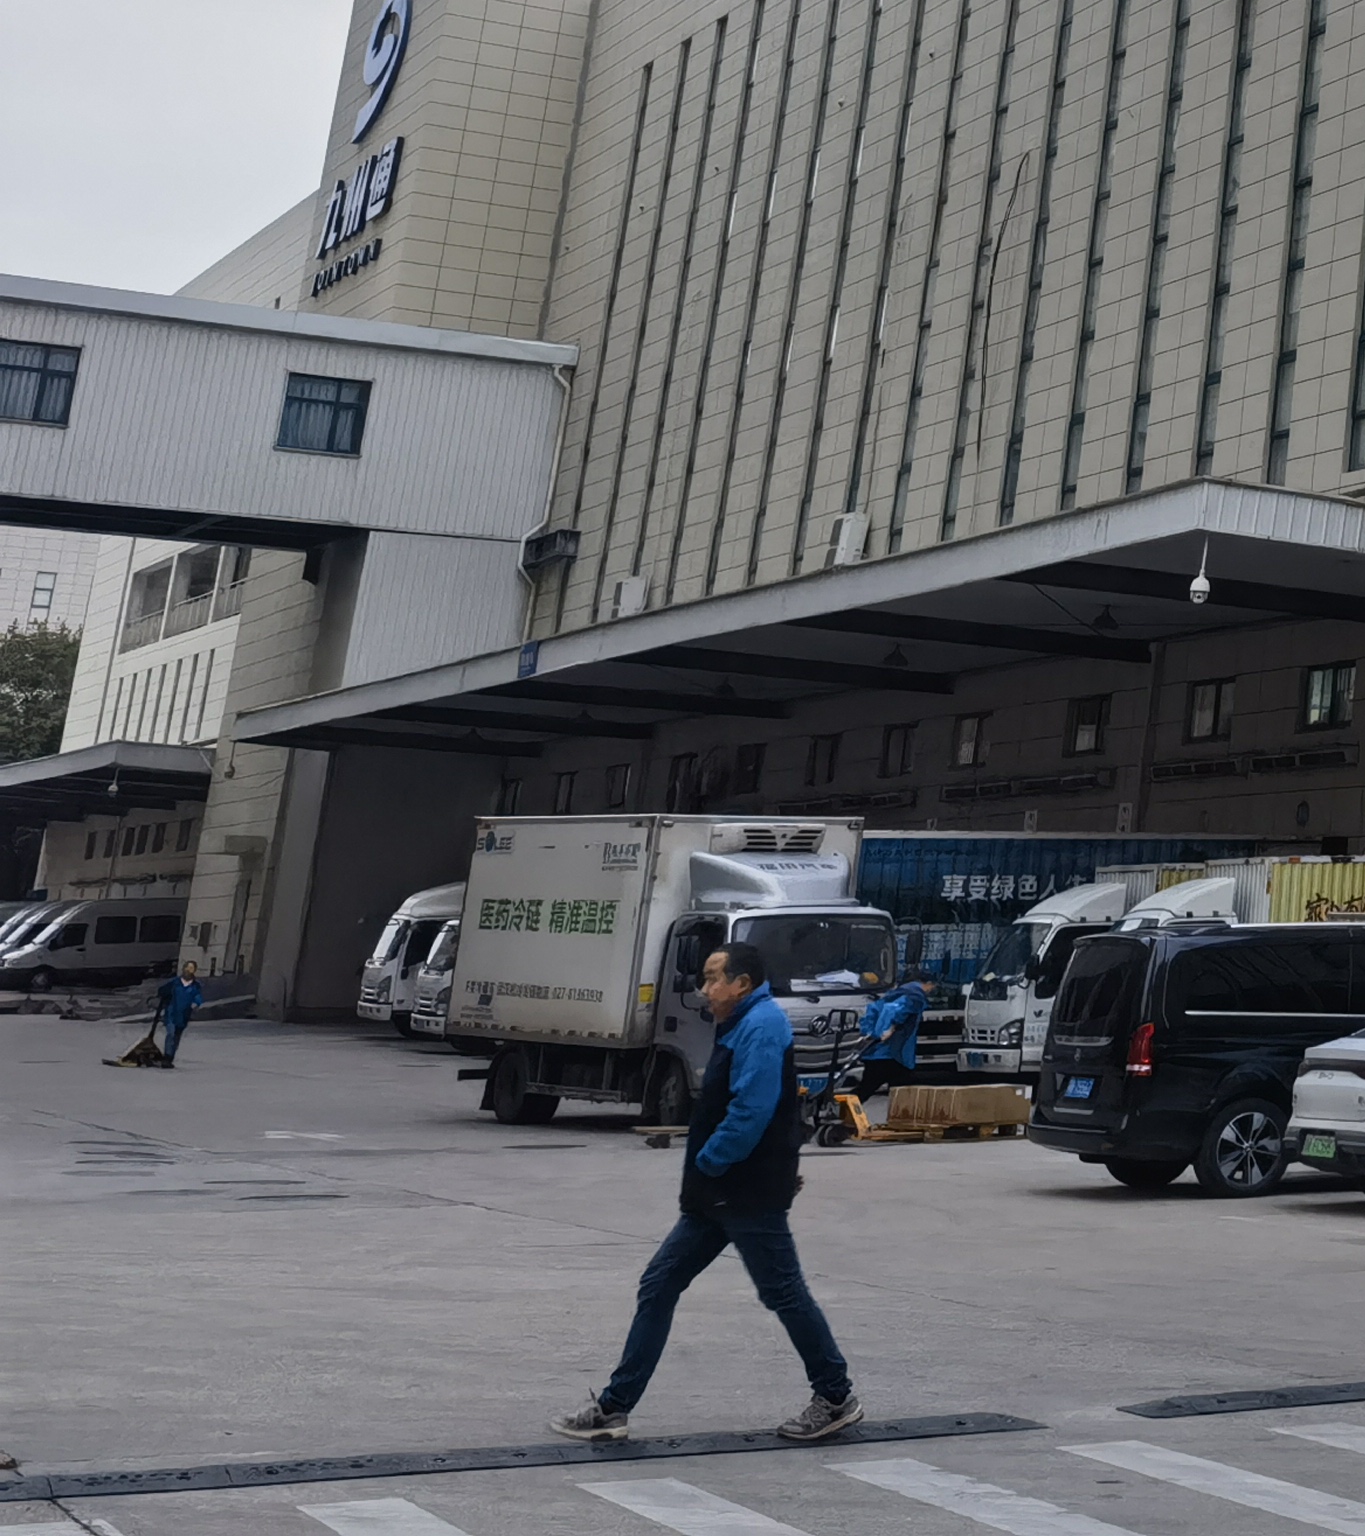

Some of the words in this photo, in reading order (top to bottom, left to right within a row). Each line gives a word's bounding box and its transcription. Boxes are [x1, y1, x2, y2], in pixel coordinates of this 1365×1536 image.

[315, 136, 404, 259] 九州通
[311, 238, 382, 297] JOINTOWN
[478, 898, 544, 931] 医药冷链
[549, 899, 621, 934] 精准温控
